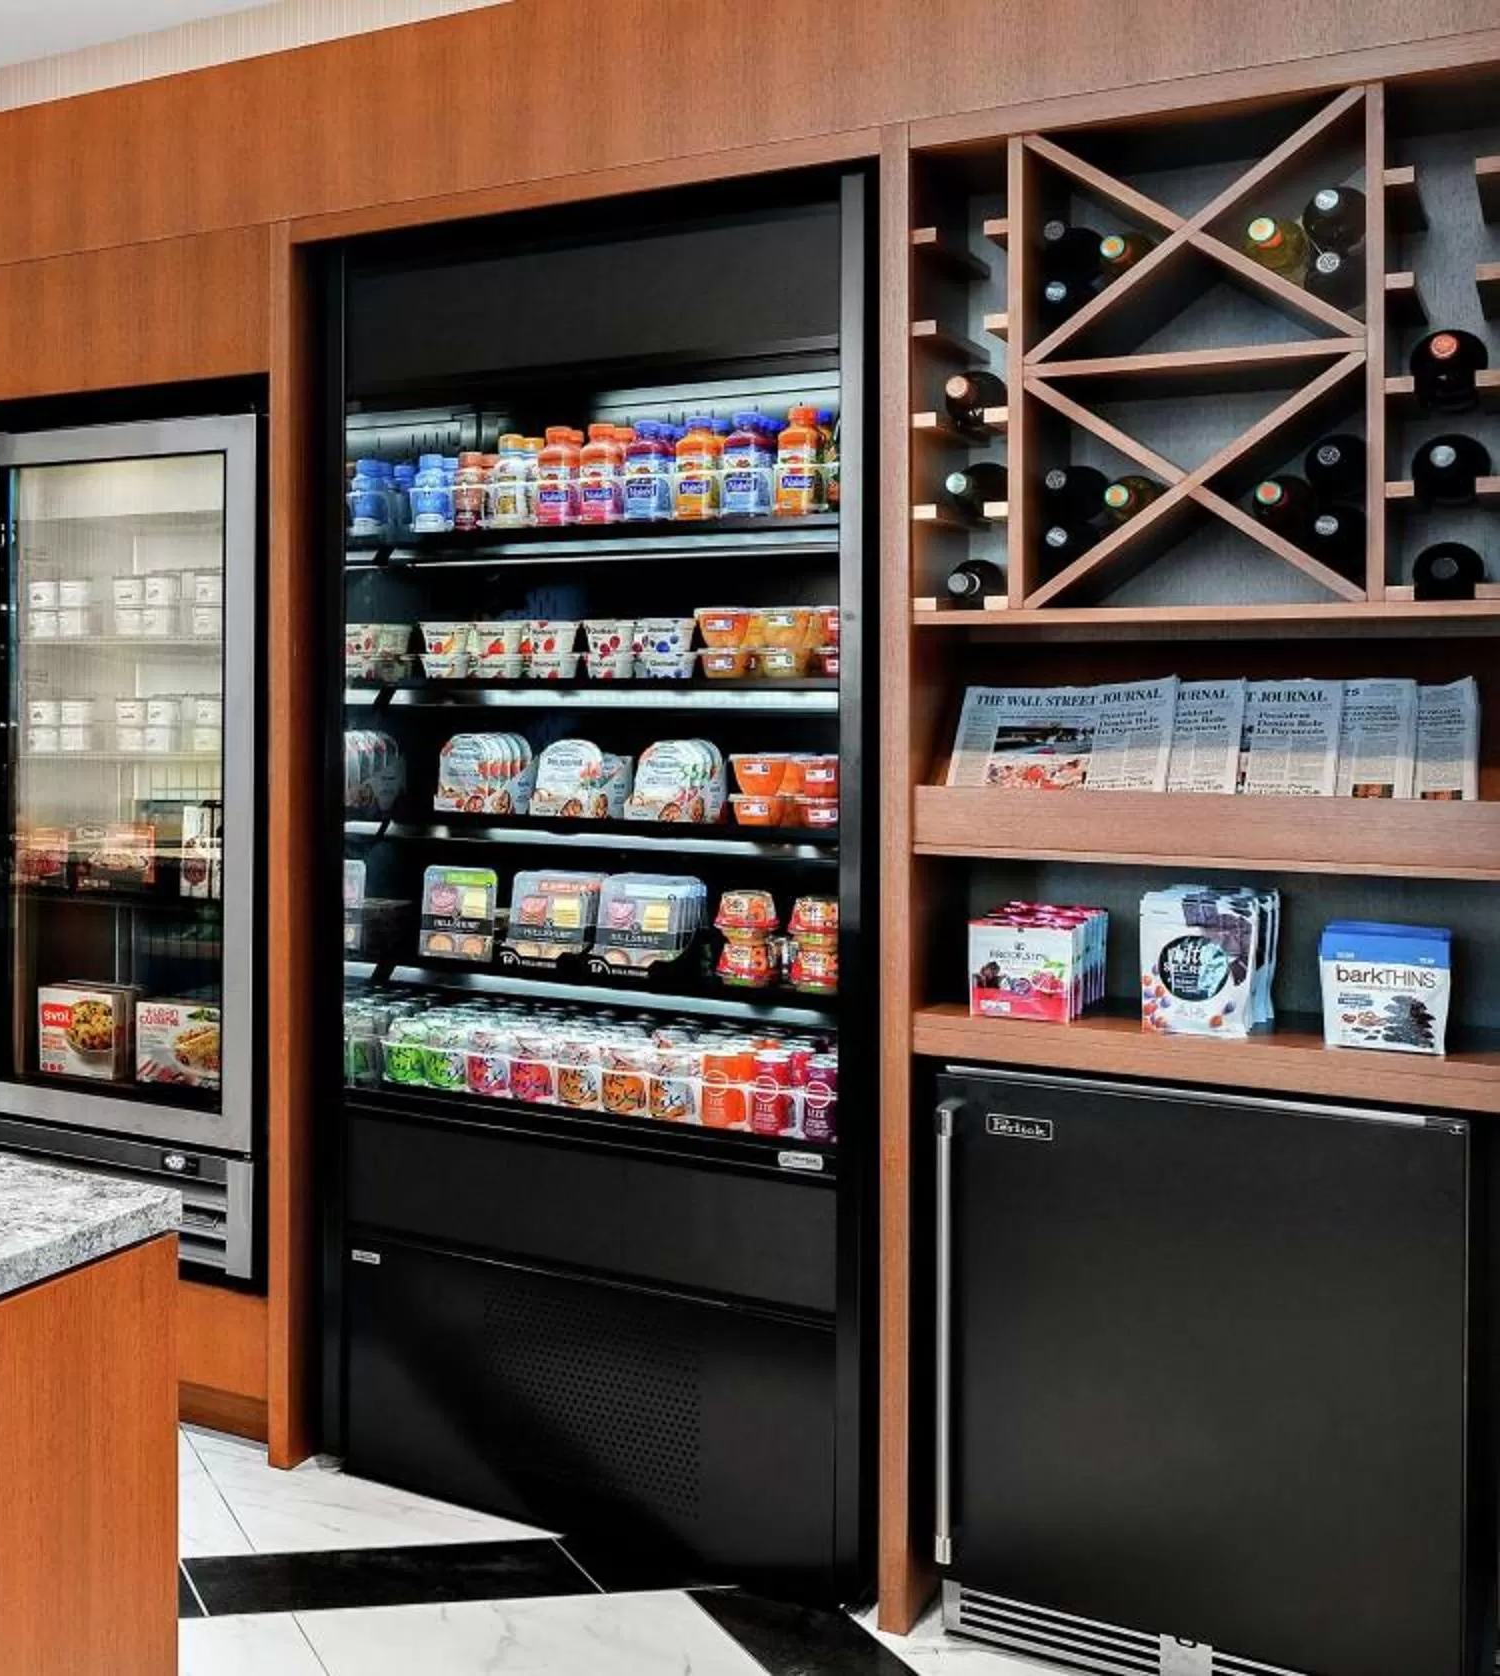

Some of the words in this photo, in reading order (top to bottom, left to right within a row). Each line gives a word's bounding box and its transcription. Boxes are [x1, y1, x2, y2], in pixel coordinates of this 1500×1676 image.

[977, 694, 1004, 706] THE
[1007, 694, 1043, 707] WALL
[1045, 694, 1098, 706] STREET
[1100, 687, 1162, 704] JOURNAL
[1177, 688, 1229, 701] URNAL
[1257, 689, 1327, 703] JOURNAL
[1336, 963, 1436, 988] barkTHINS
